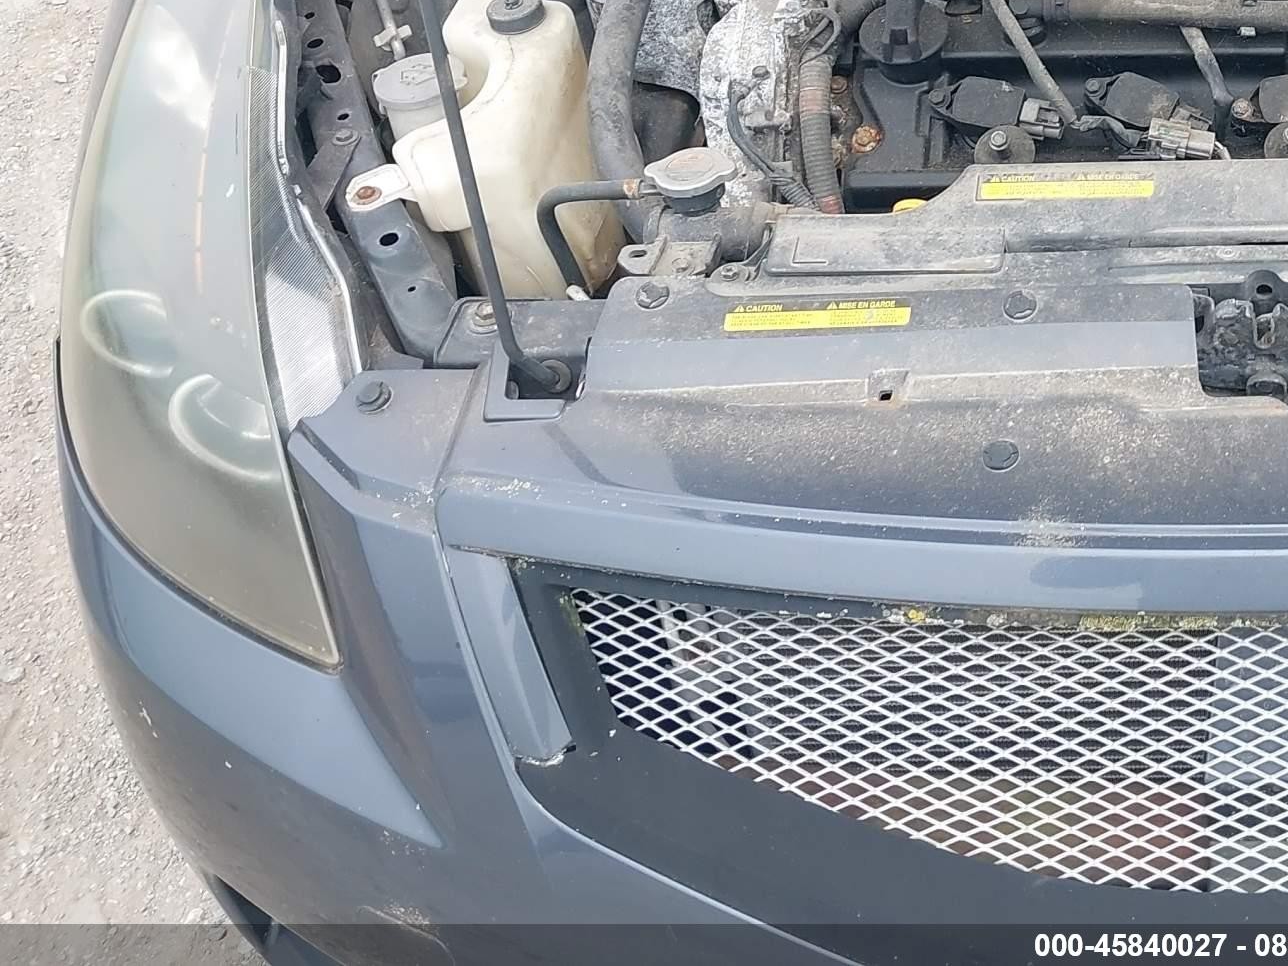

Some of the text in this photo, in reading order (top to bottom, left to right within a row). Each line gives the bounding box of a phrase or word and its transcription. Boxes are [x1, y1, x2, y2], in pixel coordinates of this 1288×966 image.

[746, 304, 783, 312] CAUTION
[838, 300, 896, 309] MISE EN GARDE
